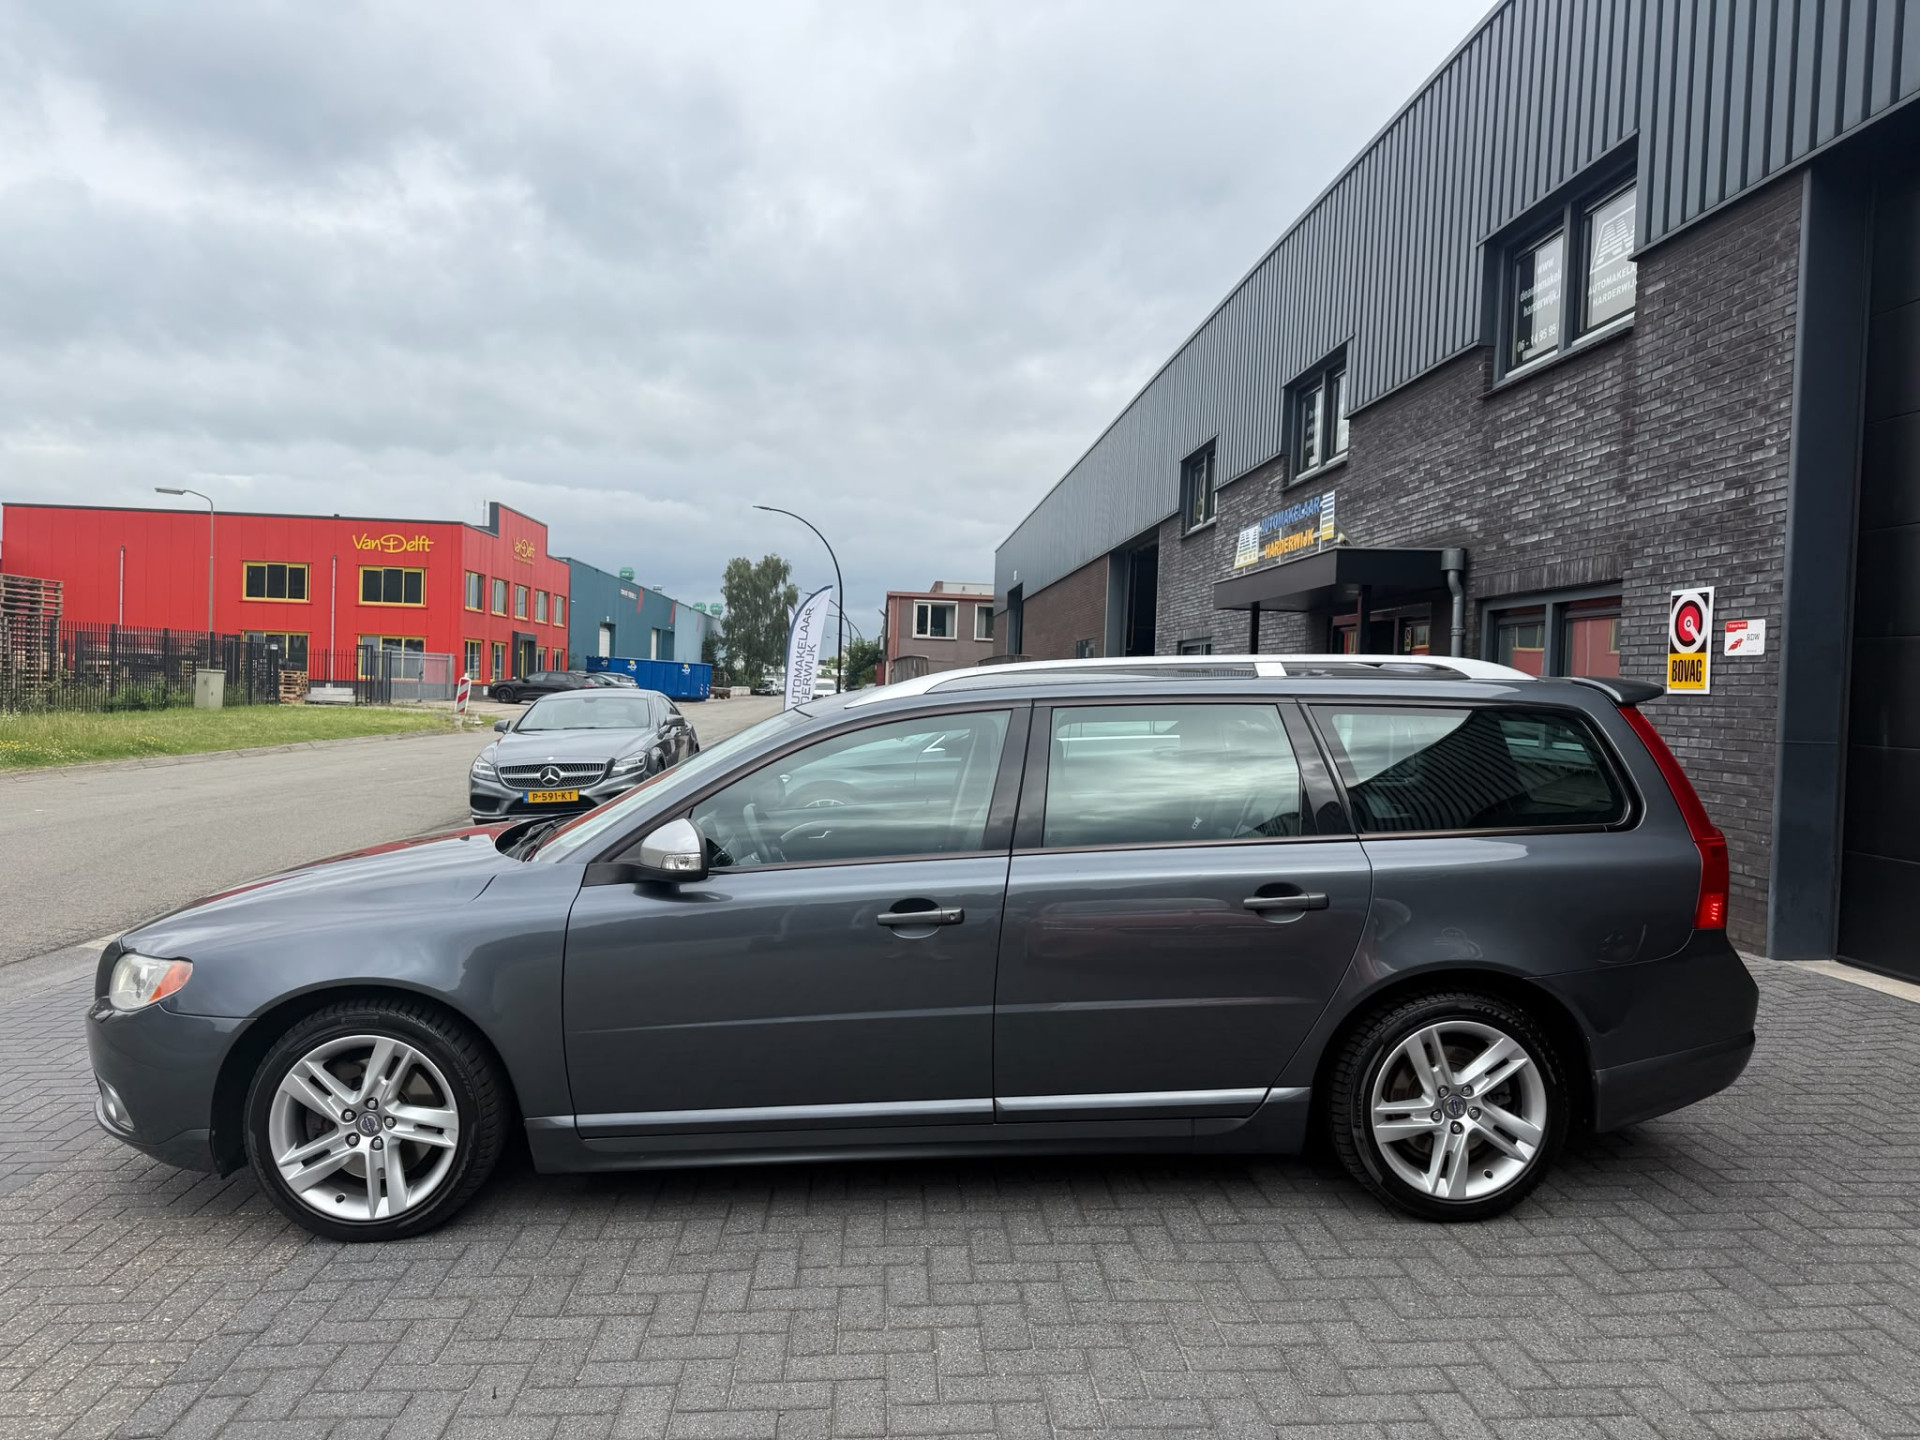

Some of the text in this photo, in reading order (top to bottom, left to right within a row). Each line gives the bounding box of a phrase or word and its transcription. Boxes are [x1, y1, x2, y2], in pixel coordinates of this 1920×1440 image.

[1520, 268, 1561, 302] deautomakel
[1588, 262, 1637, 296] AUTOMAKELA
[1592, 278, 1637, 308] HARDERWIJ
[1261, 496, 1320, 534] AUTOMAKELAAR
[1264, 528, 1314, 559] HARDERWIJK
[791, 606, 815, 705] UTOMAKELAAR
[1672, 659, 1702, 683] BOVAG
[800, 643, 817, 704] DERWIJK
[532, 791, 573, 801] P-591-KT
